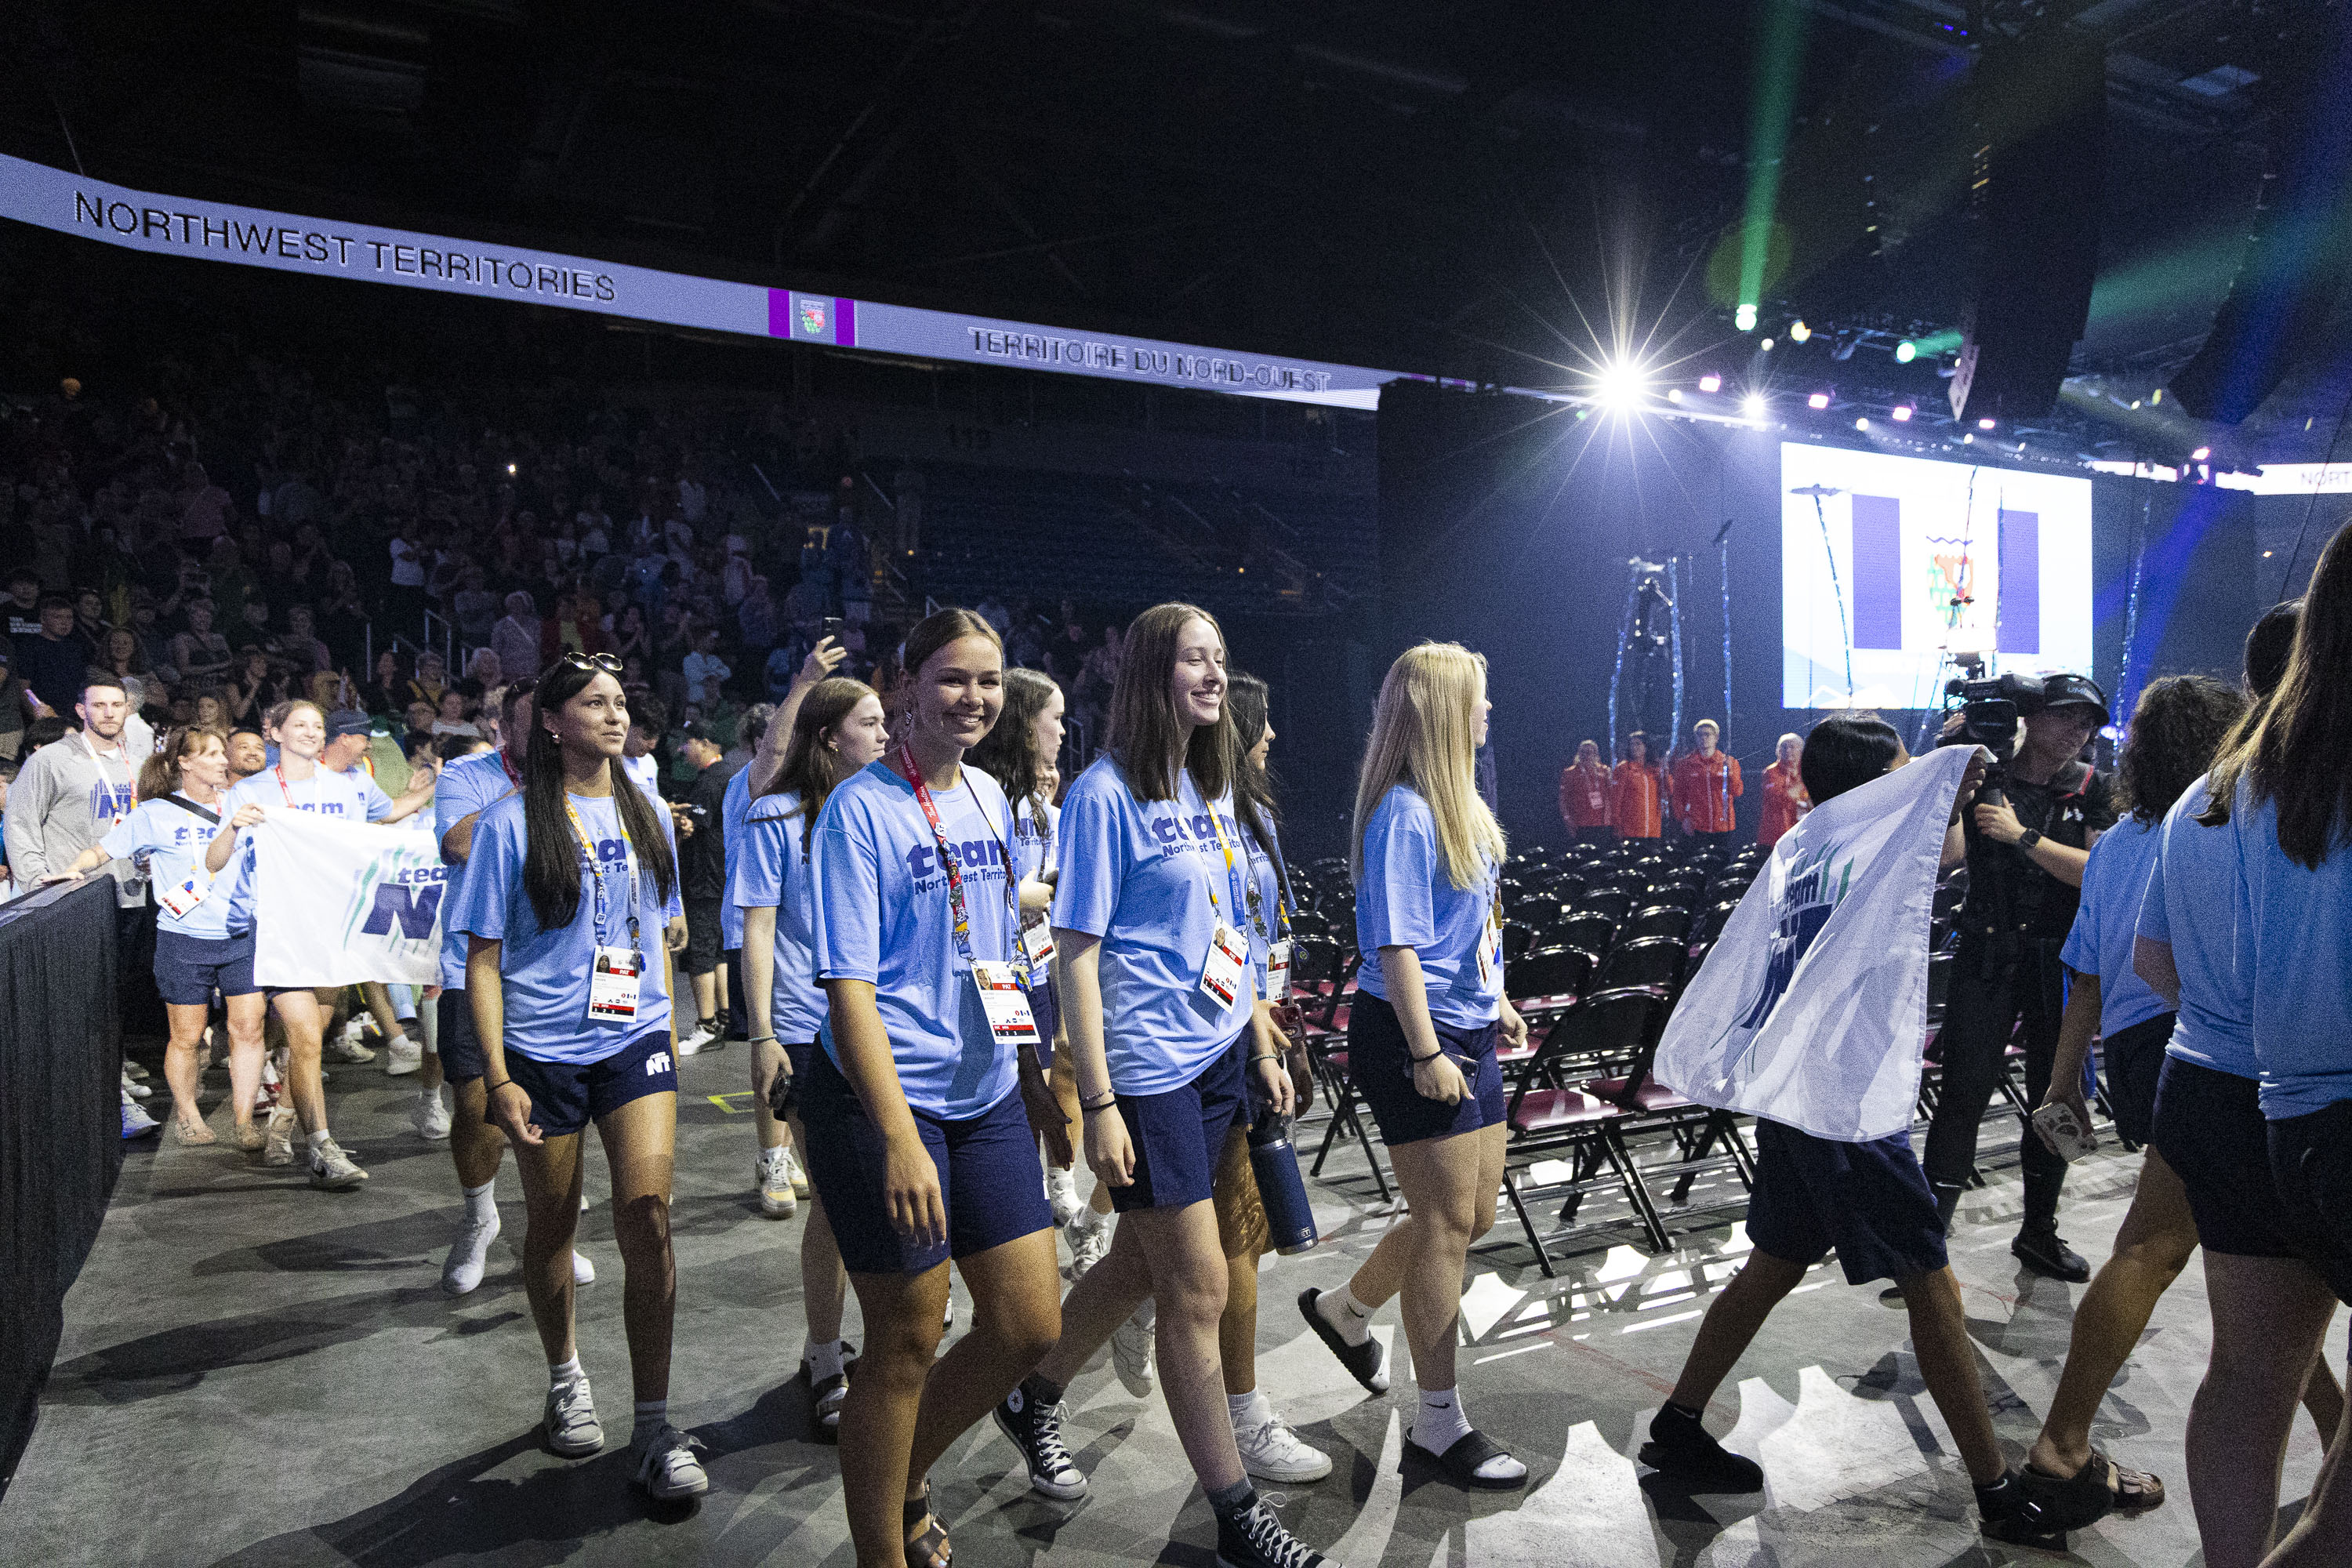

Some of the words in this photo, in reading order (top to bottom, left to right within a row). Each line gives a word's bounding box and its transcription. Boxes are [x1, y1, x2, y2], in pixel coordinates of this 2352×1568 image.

[74, 190, 356, 267] NORTHWEST
[366, 241, 616, 303] TERRITORIES
[967, 326, 1127, 372] TERRITOIRE
[1134, 347, 1171, 376] DU
[1177, 353, 1332, 392] NORD-OUEST
[646, 1055, 670, 1076] NT
